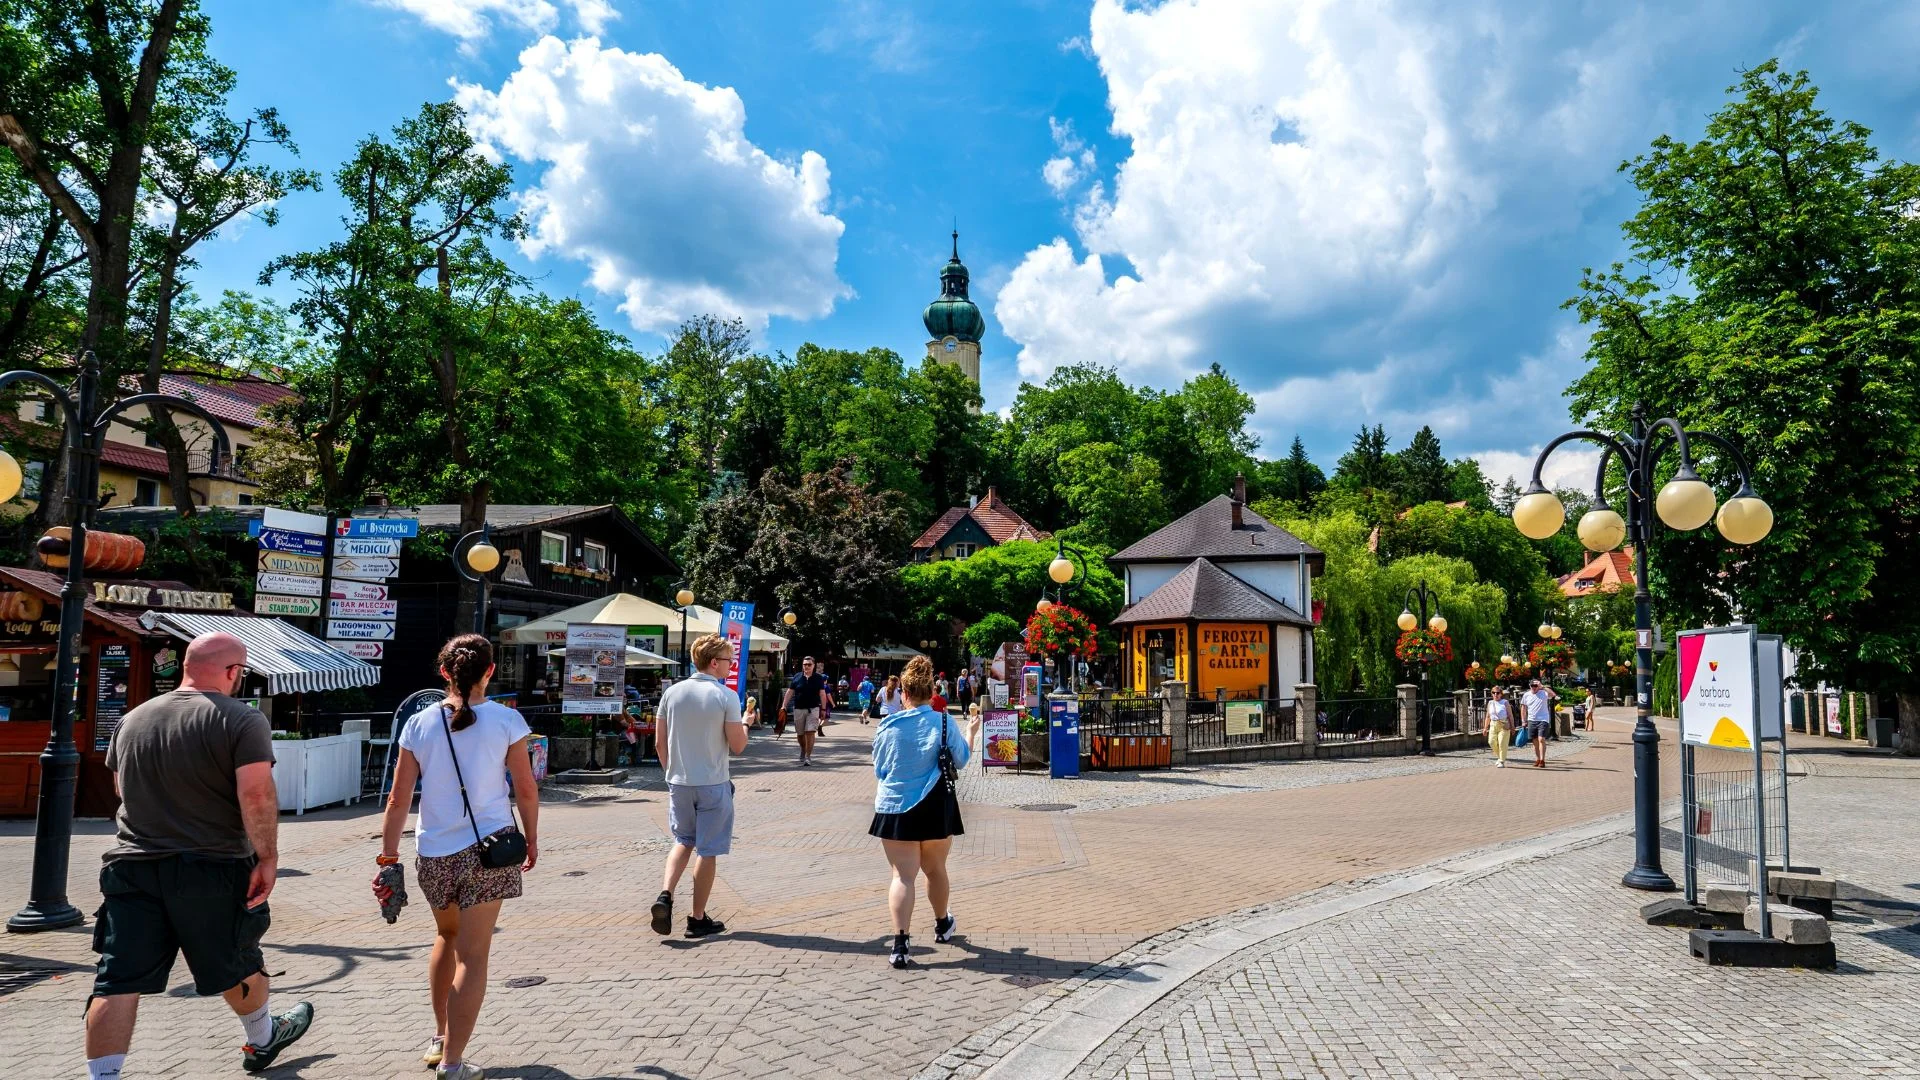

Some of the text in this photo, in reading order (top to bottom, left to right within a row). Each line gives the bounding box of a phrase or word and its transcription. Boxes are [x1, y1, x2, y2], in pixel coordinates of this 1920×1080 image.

[360, 522, 408, 535] ul. Bystrzycka
[350, 544, 391, 554] MEDICUS
[271, 558, 320, 573] MIRANDA
[93, 582, 235, 610] LODY TAJSKIE
[269, 604, 290, 613] STARY
[729, 610, 745, 620] 0.0
[5, 622, 32, 635] Lody
[332, 622, 382, 630] TARGOWISKO
[545, 632, 567, 640] TYSK
[1149, 639, 1164, 648] ART
[1221, 644, 1249, 657] ART
[1209, 659, 1260, 669] GALLERY
[1700, 686, 1730, 698] barbara
